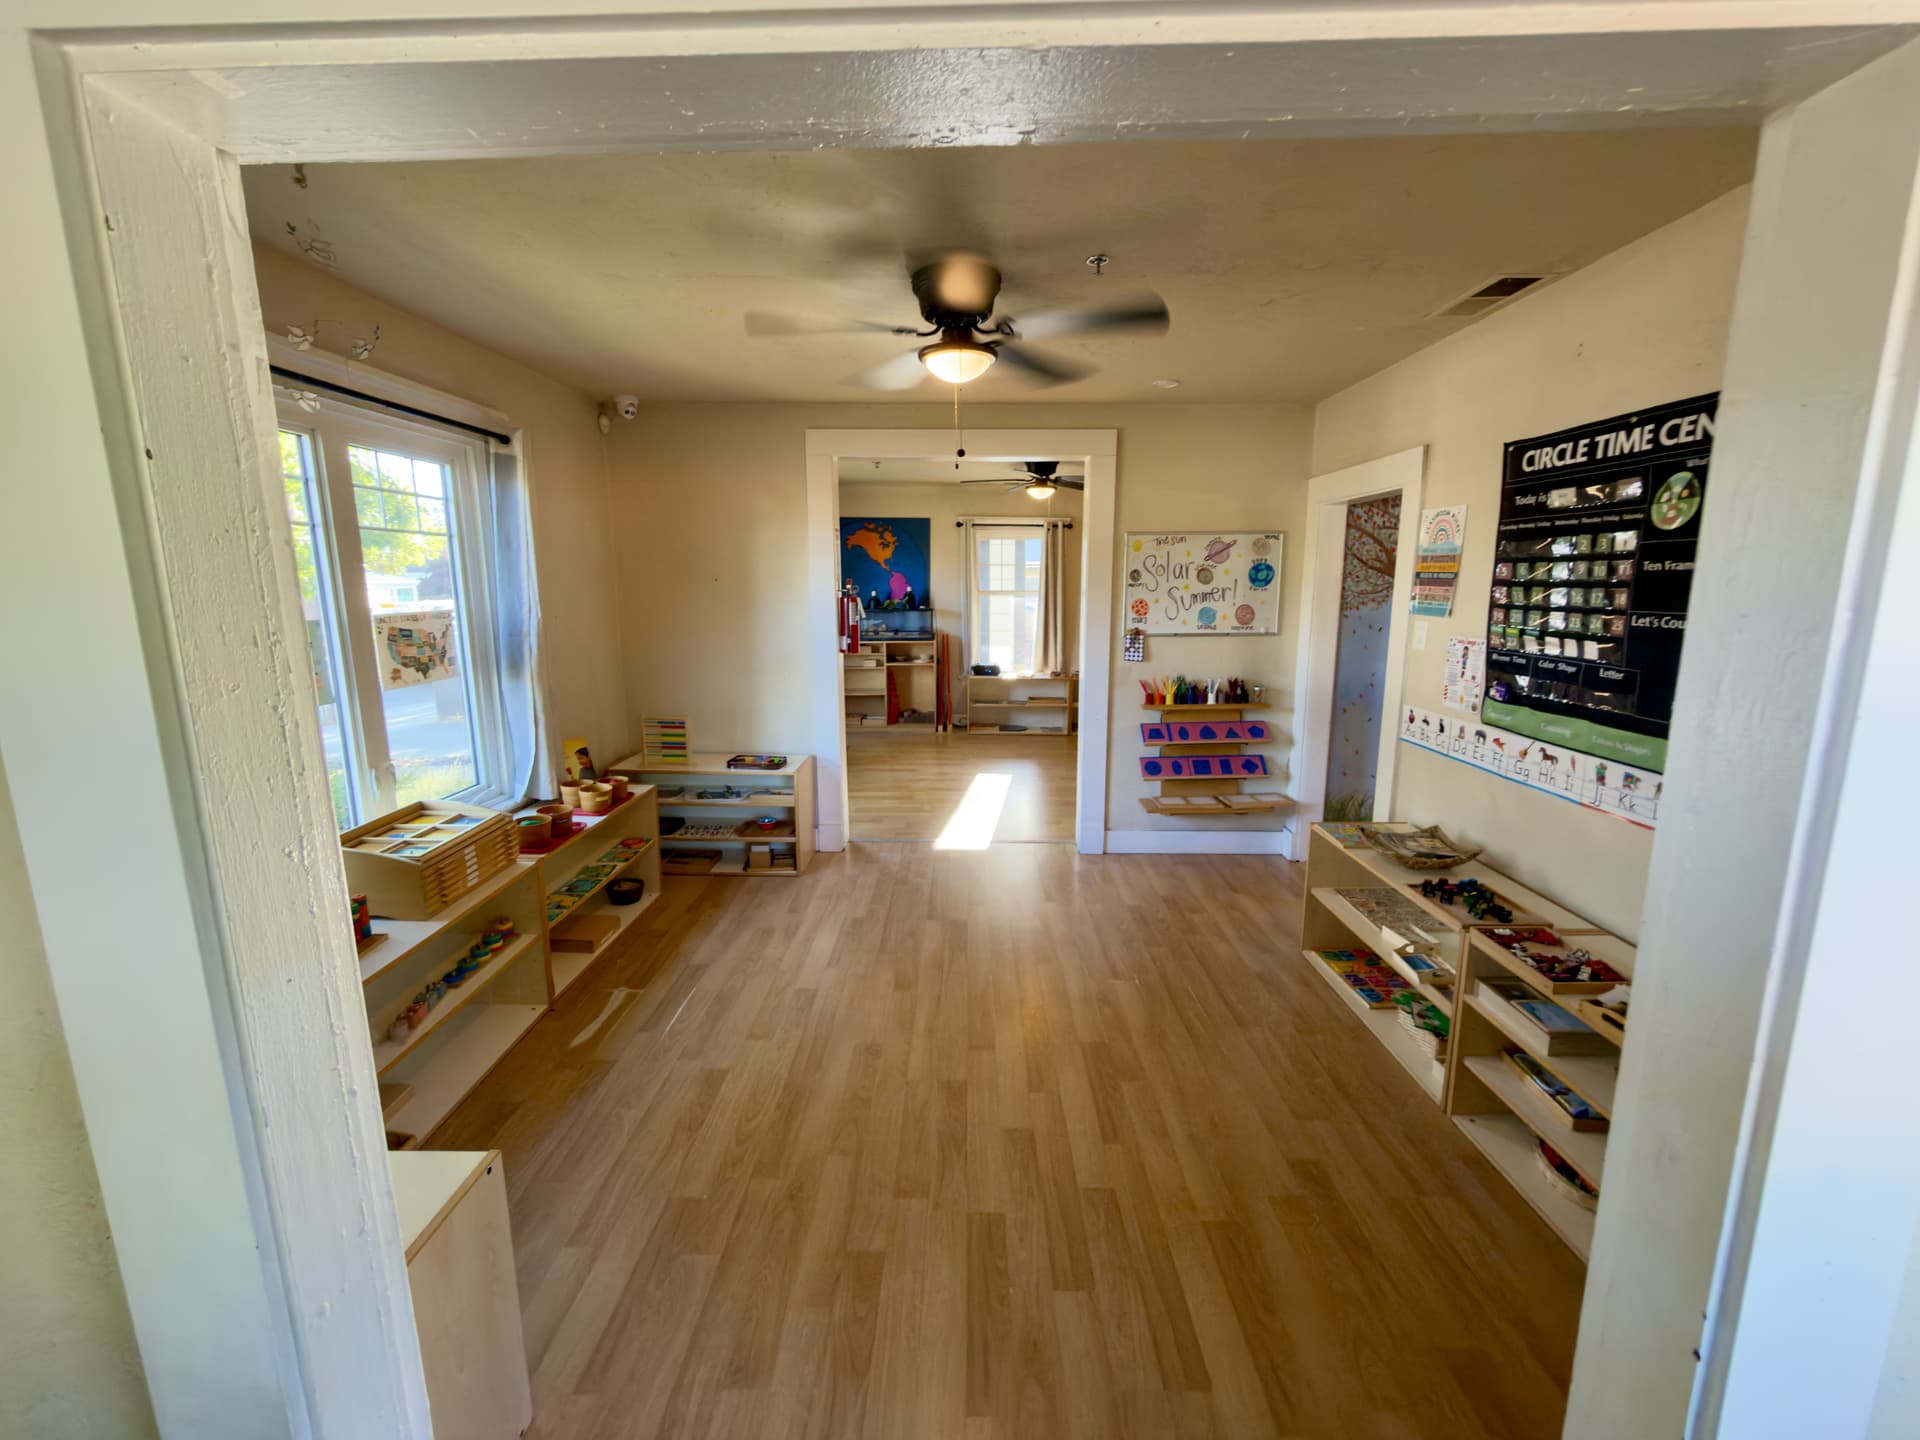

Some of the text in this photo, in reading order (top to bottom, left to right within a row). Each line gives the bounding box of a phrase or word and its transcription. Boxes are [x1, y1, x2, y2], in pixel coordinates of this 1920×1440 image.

[1521, 438, 1591, 472] CIRCLE
[1594, 424, 1655, 459] TIME
[1515, 494, 1537, 506] Today
[1142, 551, 1195, 593] Solar
[1643, 561, 1662, 571] Ten
[1165, 578, 1238, 621] Summer!
[1631, 615, 1659, 628] Let's
[1599, 667, 1625, 680] Letter
[1514, 760, 1530, 782] Gg
